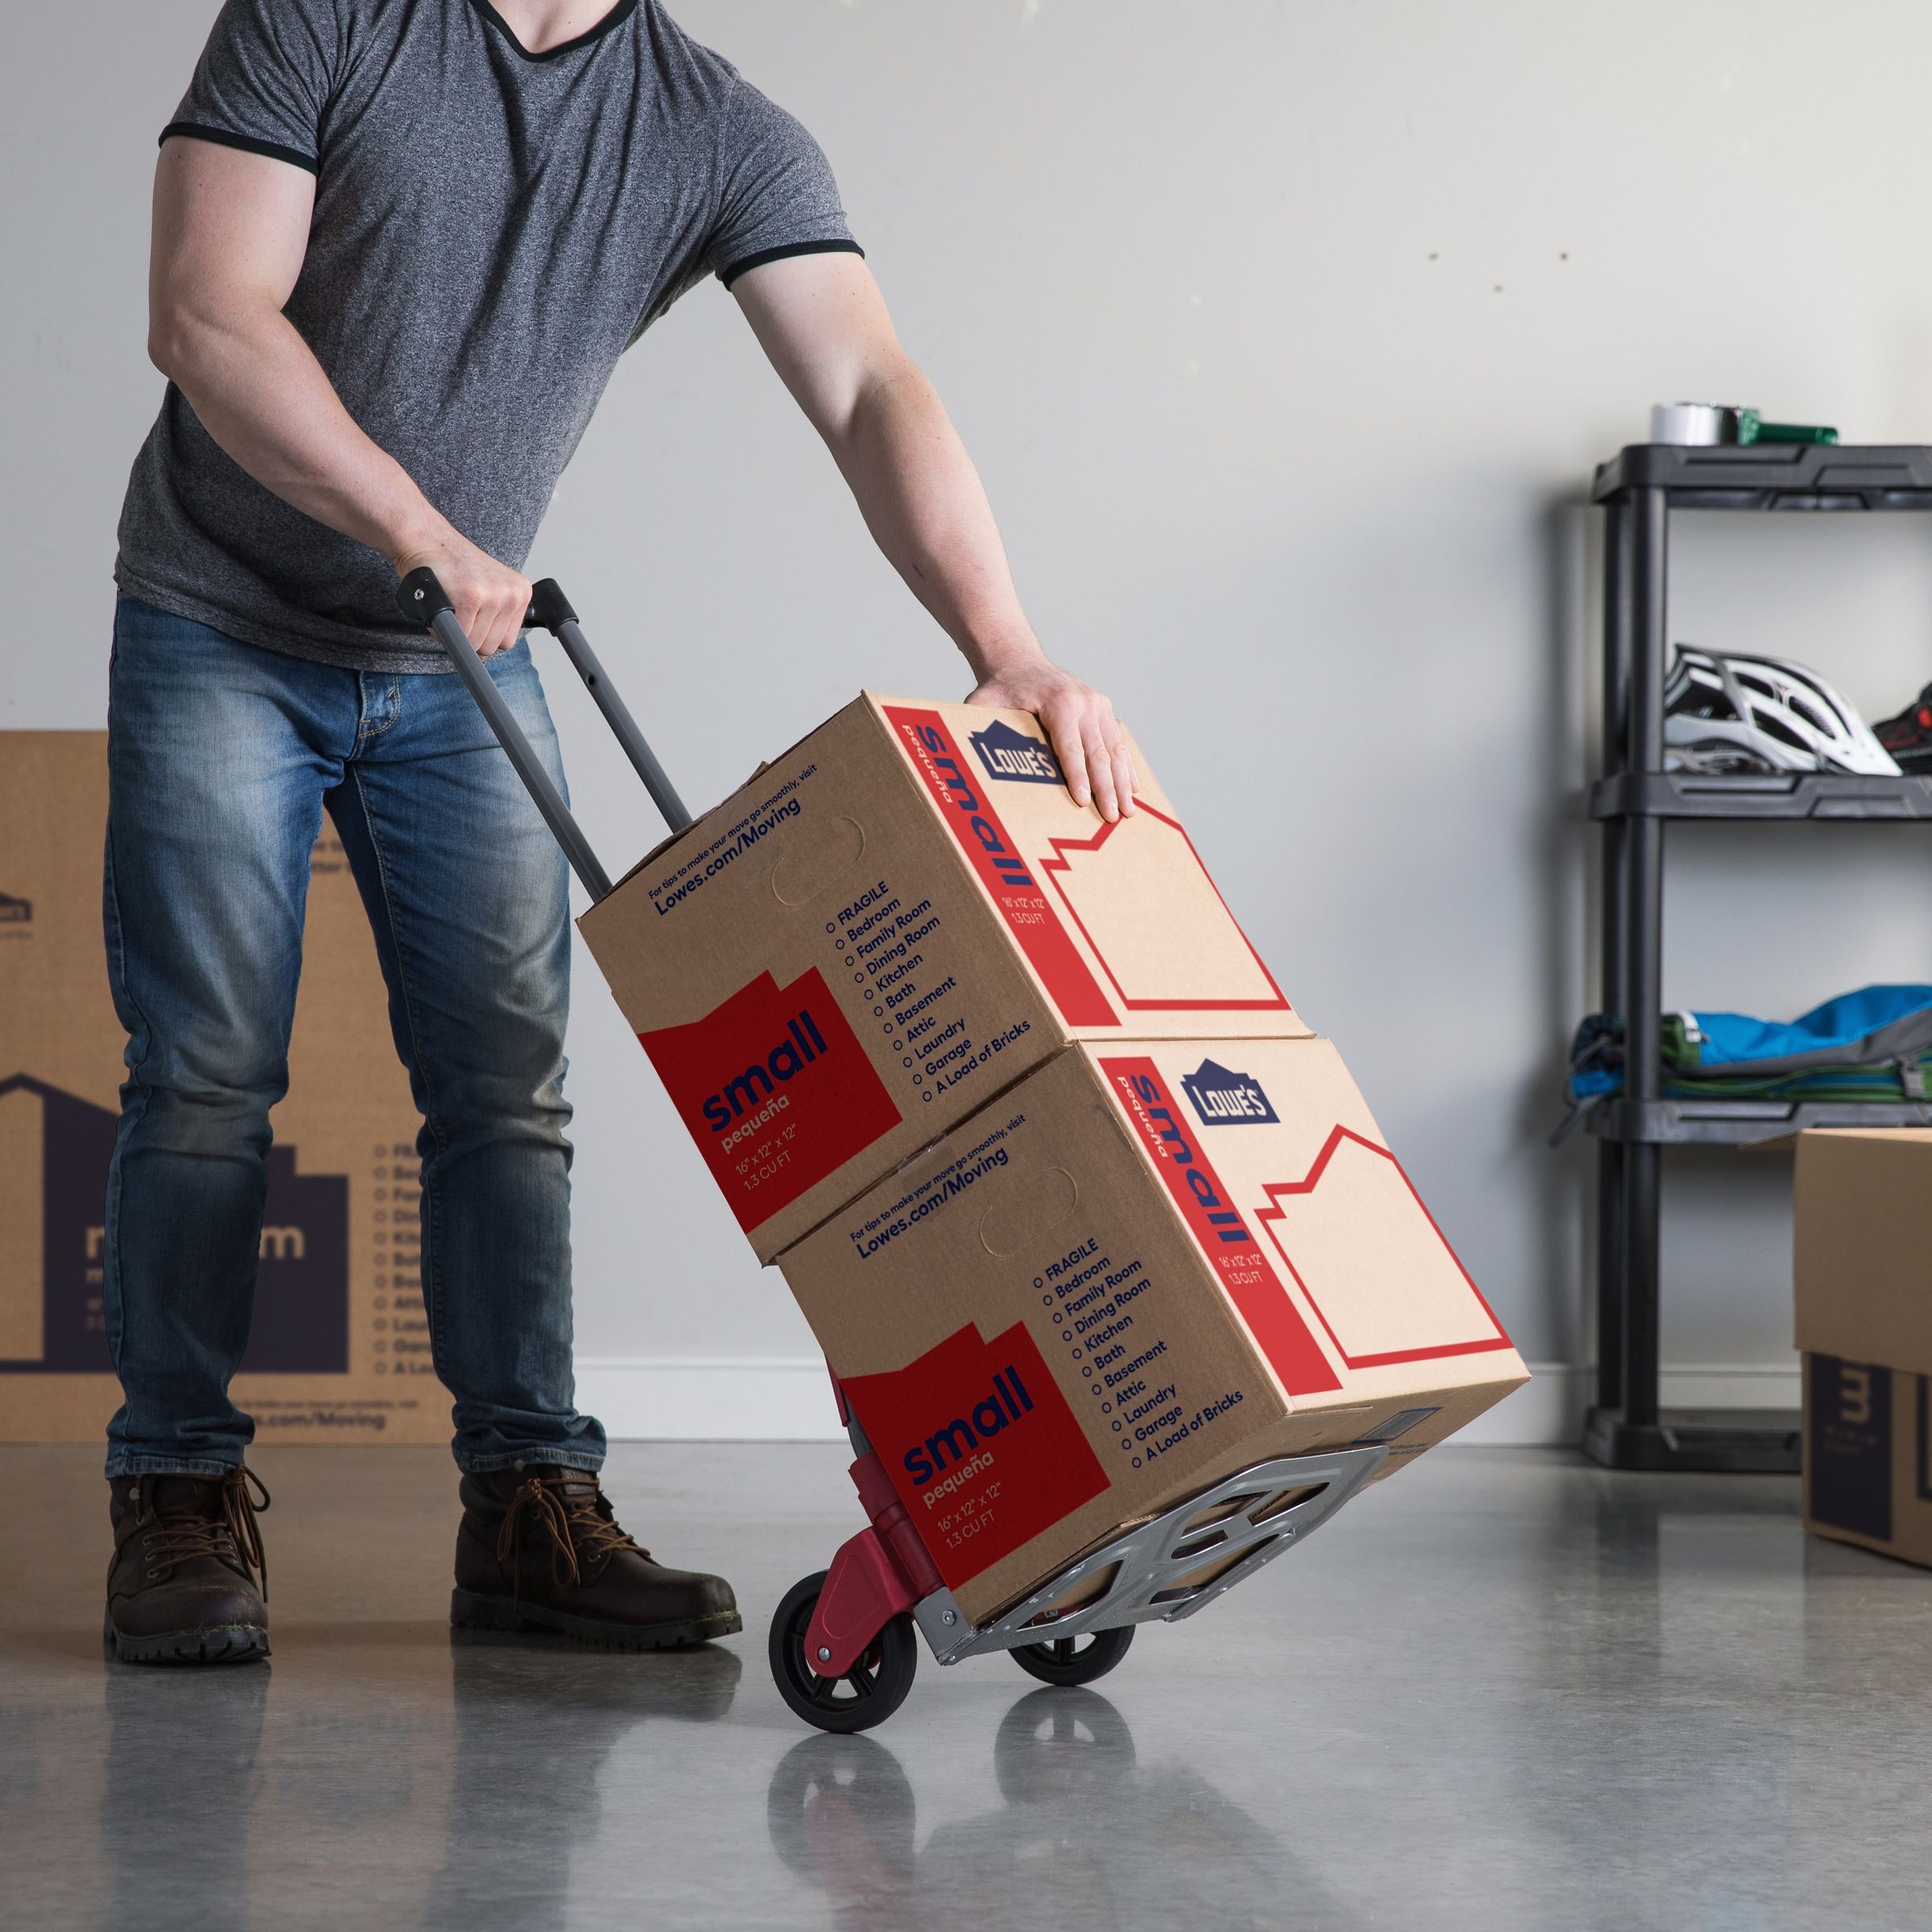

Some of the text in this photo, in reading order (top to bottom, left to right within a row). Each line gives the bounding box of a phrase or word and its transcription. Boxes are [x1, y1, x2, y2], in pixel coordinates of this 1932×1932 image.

[902, 724, 952, 803] pequeña
[915, 724, 1034, 886] small
[648, 764, 817, 900] For tips to make your move go smoothly, visit
[654, 798, 801, 916] Lowes.com/Moving
[837, 881, 889, 926] FRAGILE
[847, 898, 901, 942] Bedroom
[857, 900, 931, 959] Family Room
[865, 917, 940, 976] Dining Room
[876, 955, 923, 992] Kitchen
[885, 983, 916, 1009] Bath
[895, 976, 956, 1026] Basement
[907, 1017, 936, 1043] Attic
[914, 1018, 965, 1059] Laundry
[703, 1009, 828, 1132] small
[925, 1039, 972, 1075] Garage
[936, 1021, 1030, 1095] A Load of Bricks
[721, 1095, 790, 1154] pequeña
[1117, 1075, 1168, 1158] pequeña
[1191, 1084, 1267, 1117] LOWE'S
[744, 1150, 791, 1191] 1.3 CU FT
[751, 1155, 759, 1166] x
[774, 1137, 783, 1148] x
[1130, 1074, 1249, 1243] small
[850, 1115, 1026, 1242] For tips to make your move go smoothly, visit
[857, 1148, 1009, 1259] Lowes.com/Moving
[1045, 1237, 1099, 1281] FRAGILE
[1055, 1257, 1111, 1298] Bedroom
[1064, 1261, 1142, 1316] Family Room
[1074, 1279, 1151, 1334] Dining Room
[1084, 1315, 1133, 1352] Kitchen
[1094, 1344, 1125, 1370] Bath
[1104, 1340, 1167, 1388] Basement
[1116, 1381, 1146, 1406] Attic
[1123, 1385, 1176, 1424] Laundry
[904, 1365, 1034, 1485] small
[1134, 1406, 1183, 1441] Garage
[1146, 1391, 1243, 1461] A Load of Bricks
[923, 1451, 994, 1510] pequeña
[946, 1509, 994, 1549] 1.3 CU FT
[954, 1513, 962, 1523] x
[978, 1496, 987, 1506] x
